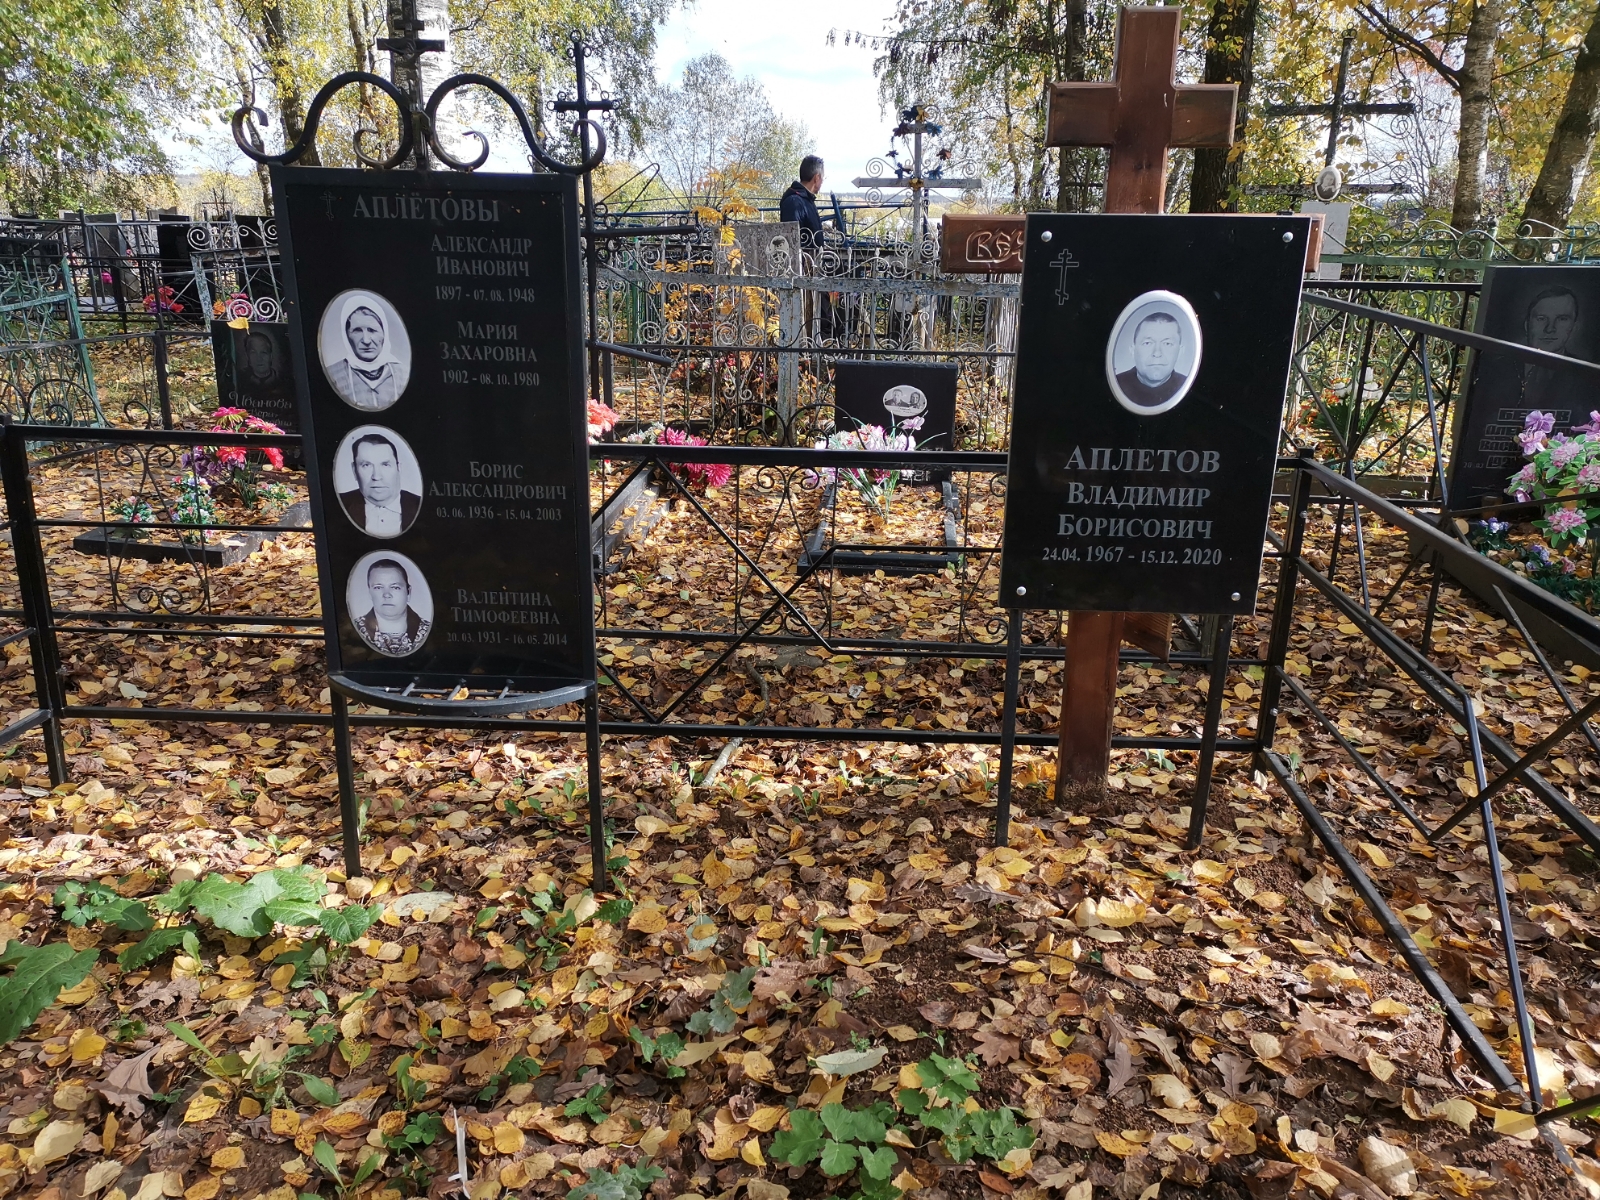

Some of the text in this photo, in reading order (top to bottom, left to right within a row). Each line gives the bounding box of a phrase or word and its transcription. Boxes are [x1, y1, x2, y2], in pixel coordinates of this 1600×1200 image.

[1064, 445, 1220, 472] АПЛЕТОВ
[1068, 482, 1210, 509] ВЛАДИМИР
[1057, 514, 1213, 539] БОРИСОВИЧ
